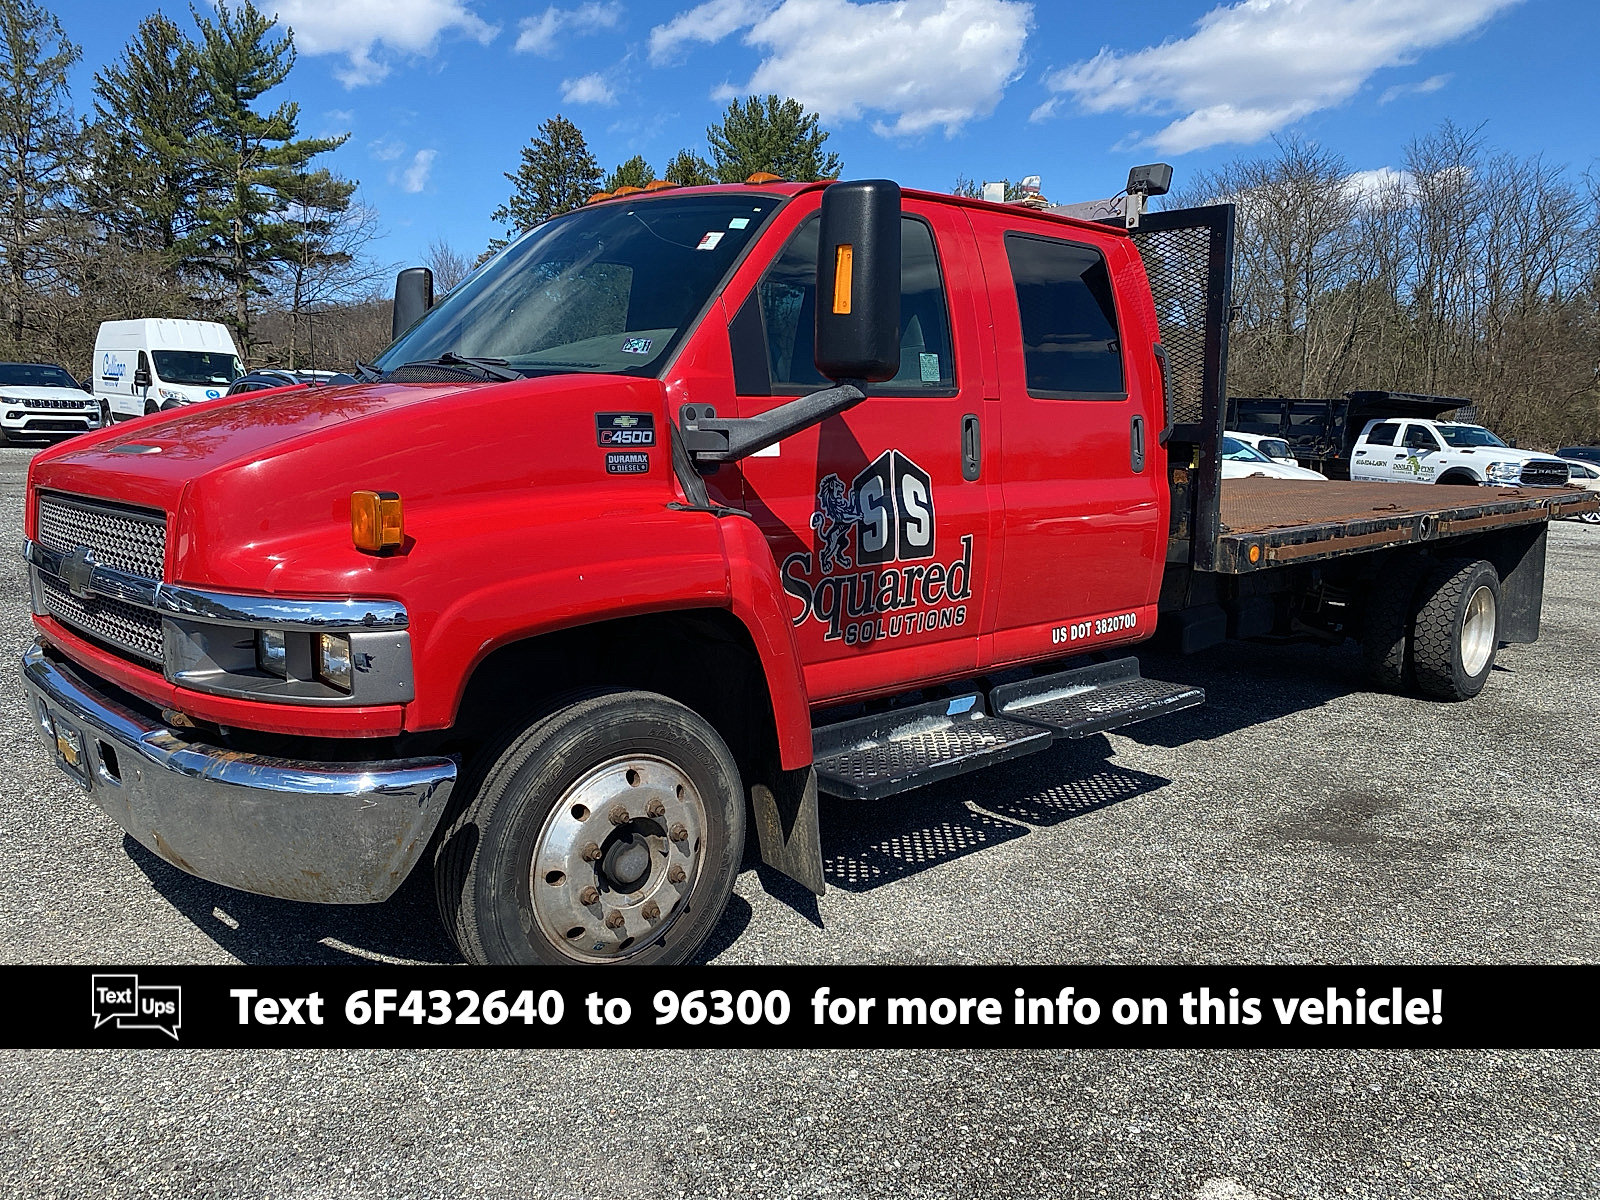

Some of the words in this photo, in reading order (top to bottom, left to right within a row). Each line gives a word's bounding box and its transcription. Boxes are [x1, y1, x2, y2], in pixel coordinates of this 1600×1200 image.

[601, 430, 653, 444] C4500
[608, 454, 648, 464] DURAMAX
[780, 534, 974, 641] Squared
[844, 606, 967, 645] SOLUTIONS
[1052, 627, 1068, 644] US
[1070, 622, 1093, 641] DOT
[1095, 612, 1137, 635] 3820700
